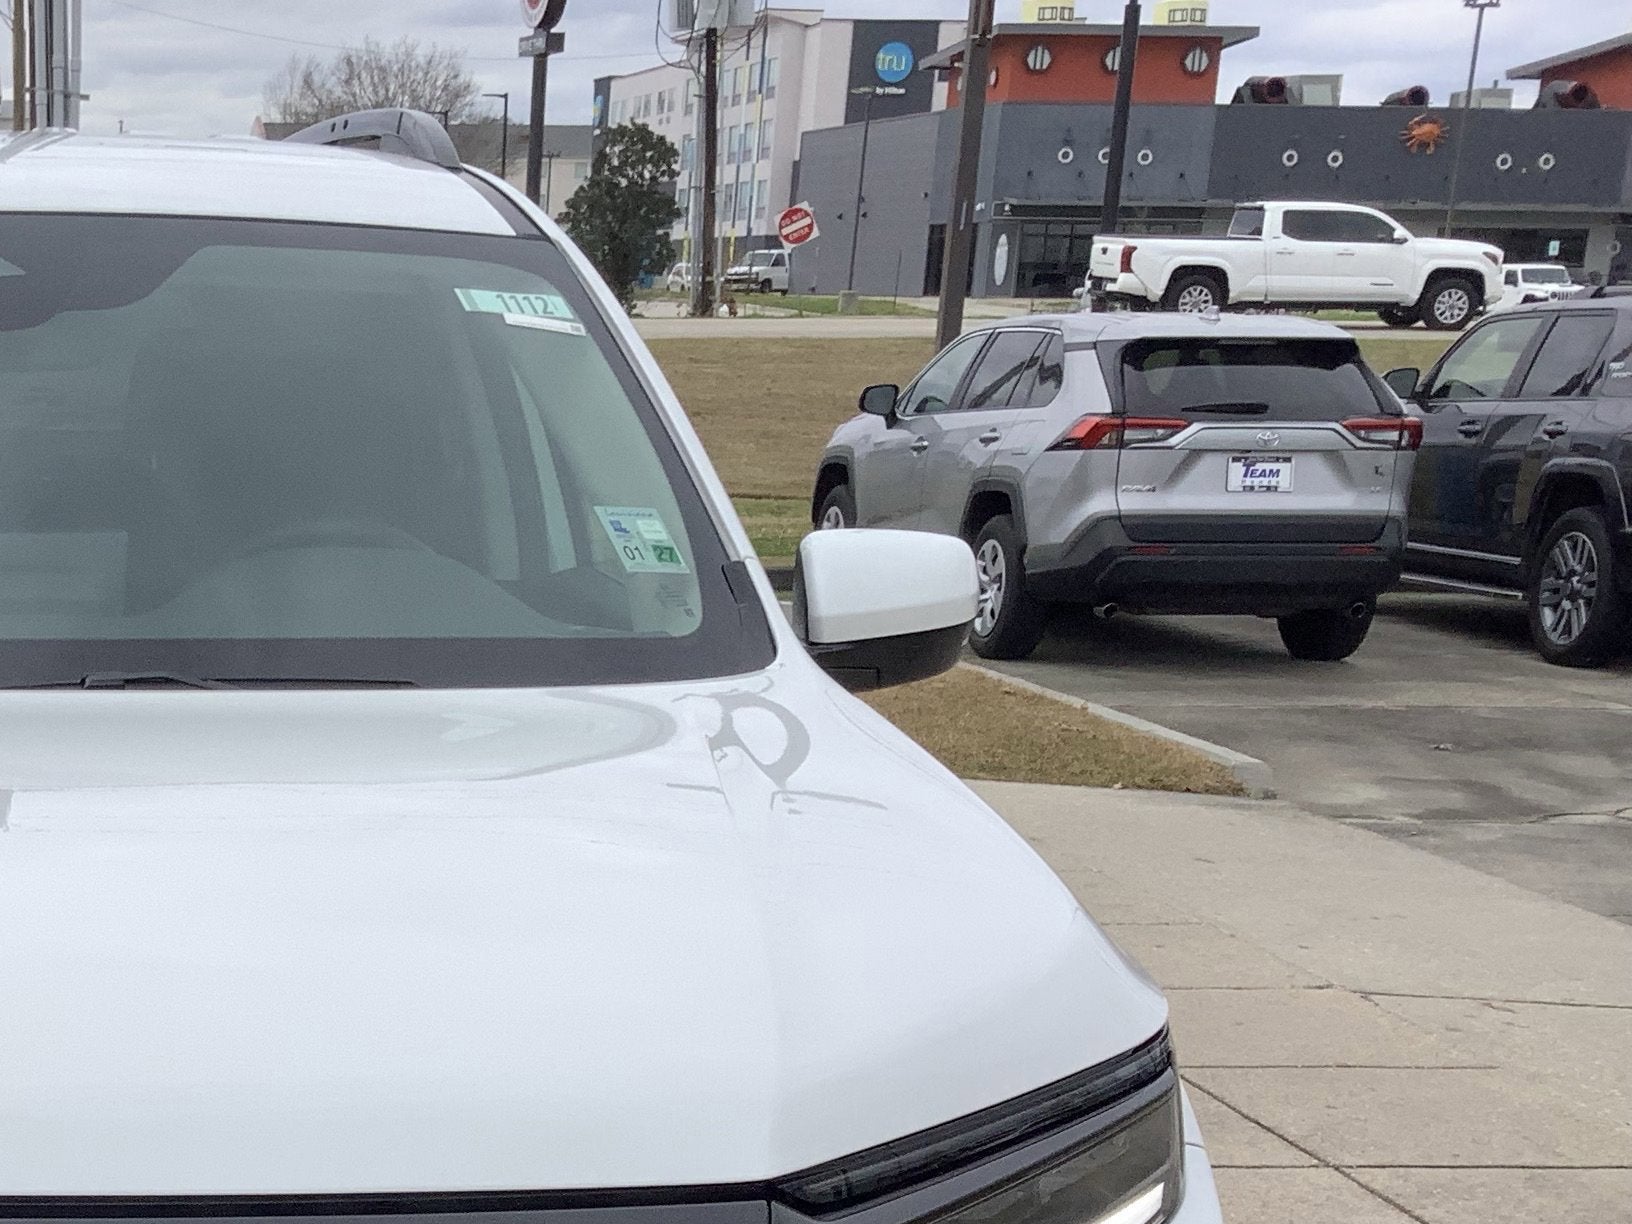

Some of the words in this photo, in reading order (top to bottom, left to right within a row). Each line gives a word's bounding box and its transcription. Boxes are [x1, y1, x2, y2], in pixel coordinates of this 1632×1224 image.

[878, 52, 906, 71] tru
[495, 294, 555, 315] 1112
[622, 545, 646, 561] 01
